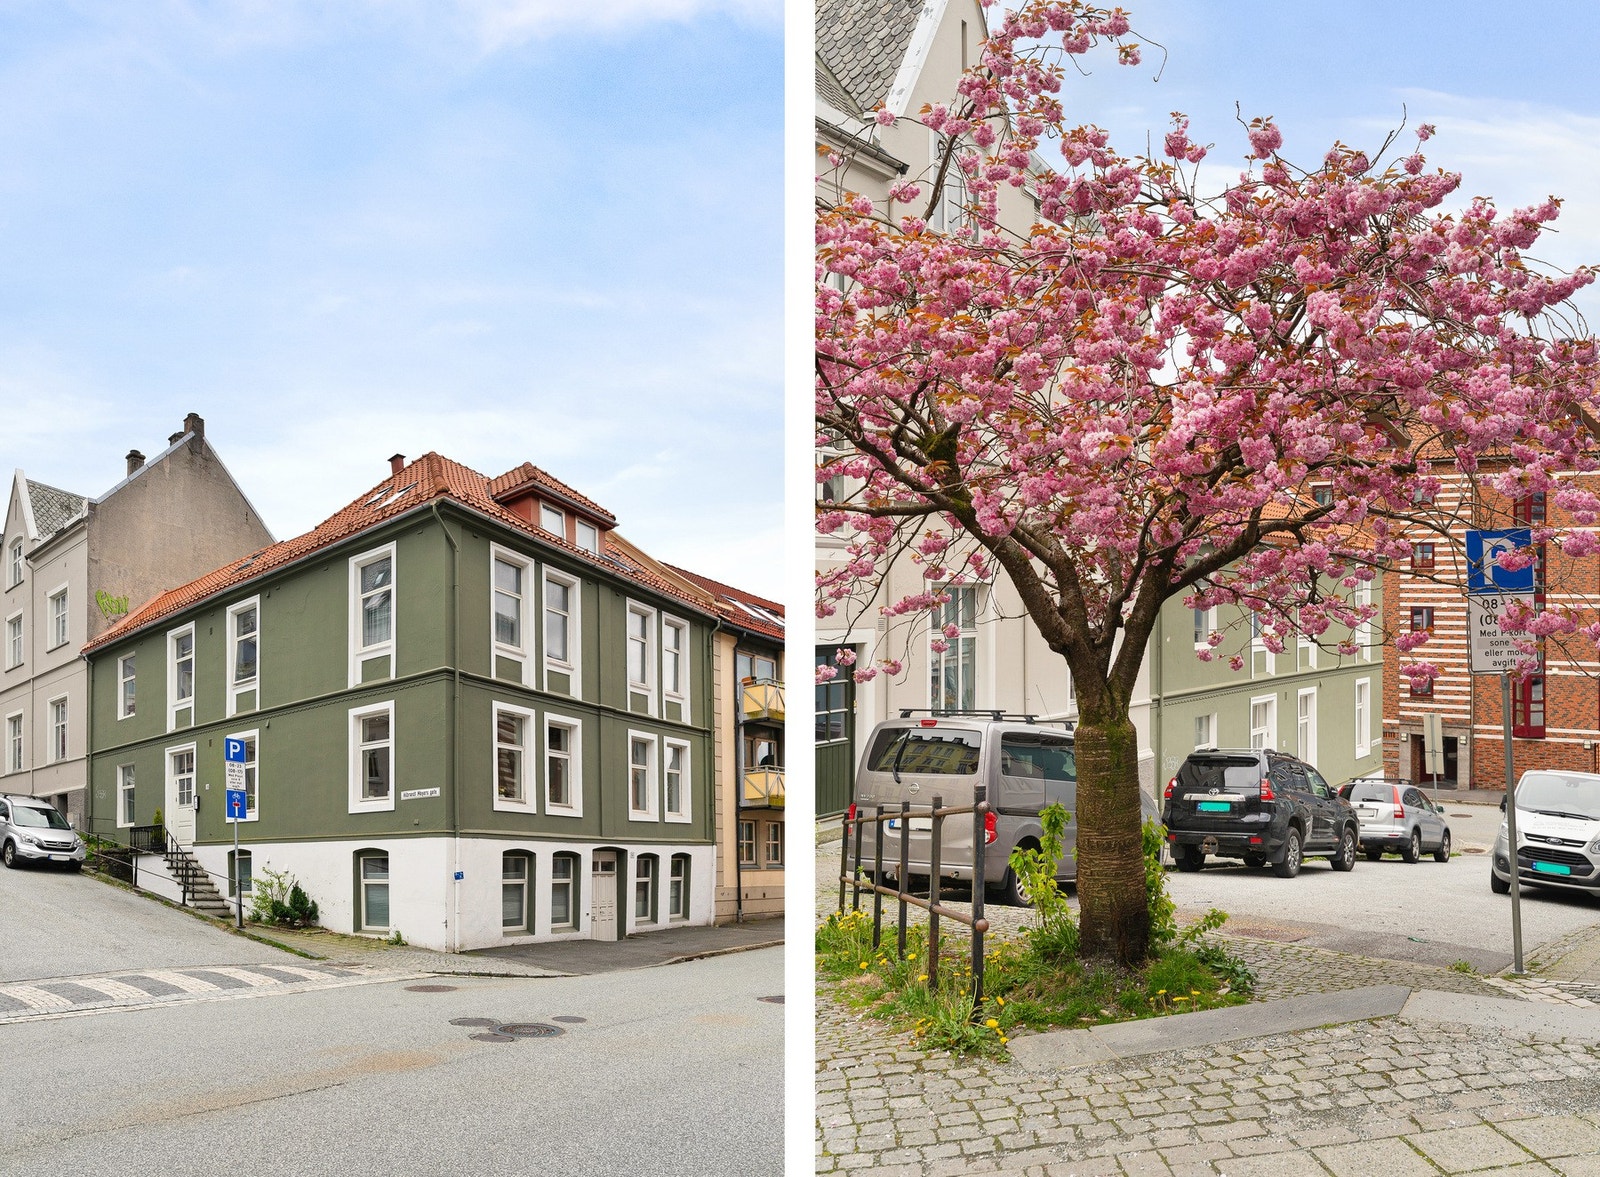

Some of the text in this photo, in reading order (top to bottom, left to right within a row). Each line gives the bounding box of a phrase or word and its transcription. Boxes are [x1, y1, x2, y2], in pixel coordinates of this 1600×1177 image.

[1483, 538, 1515, 584] P
[1492, 658, 1517, 668] avgift
[230, 741, 241, 759] P
